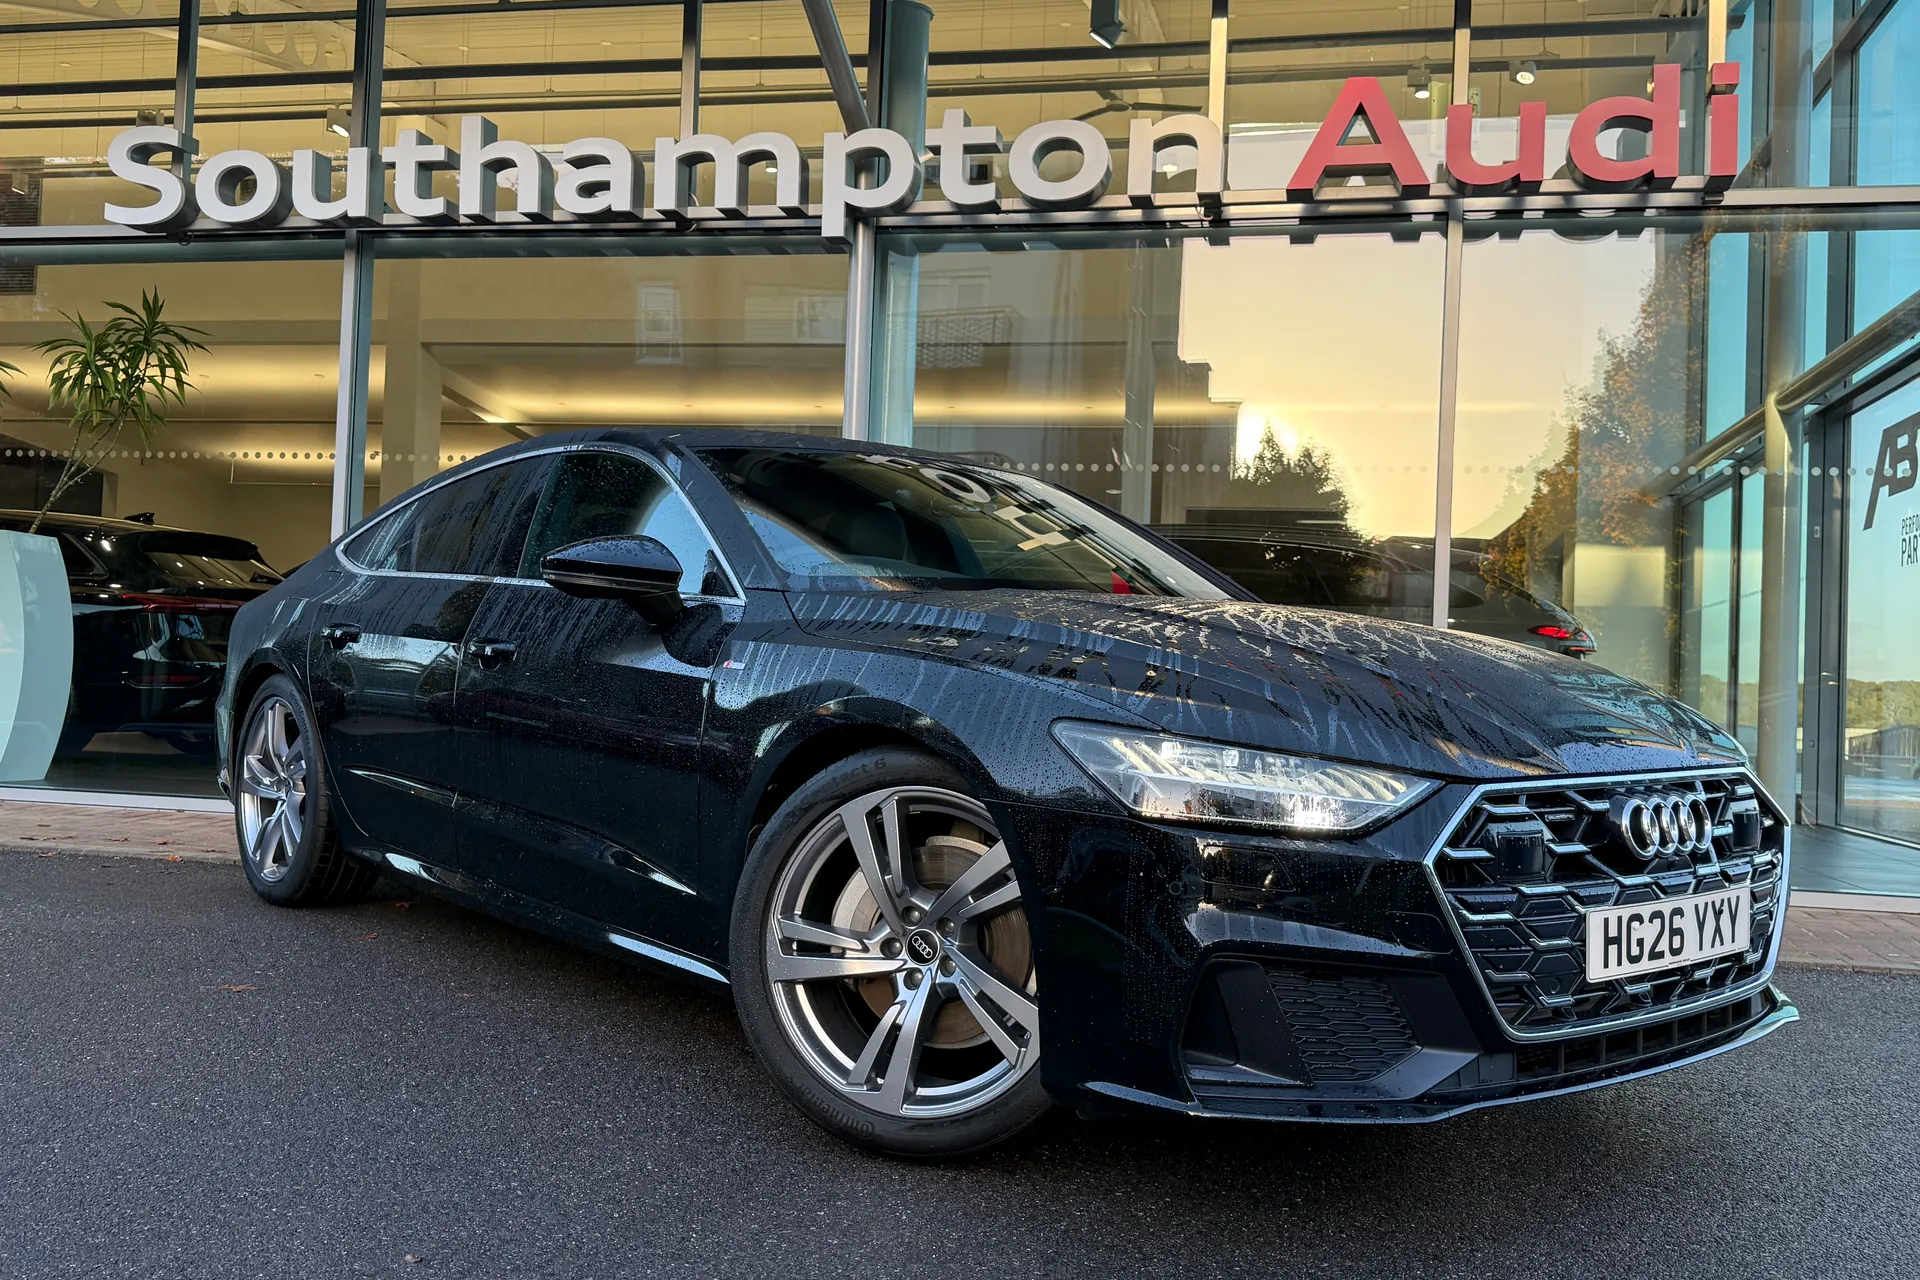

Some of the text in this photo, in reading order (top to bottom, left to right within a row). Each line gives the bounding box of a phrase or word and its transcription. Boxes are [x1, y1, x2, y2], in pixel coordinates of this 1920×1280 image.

[104, 62, 1740, 239] Southampton Audi
[1863, 412, 1920, 531] AB
[1901, 512, 1920, 536] PERFO
[1901, 533, 1920, 567] PAR
[1603, 895, 1741, 969] HG26 YXY
